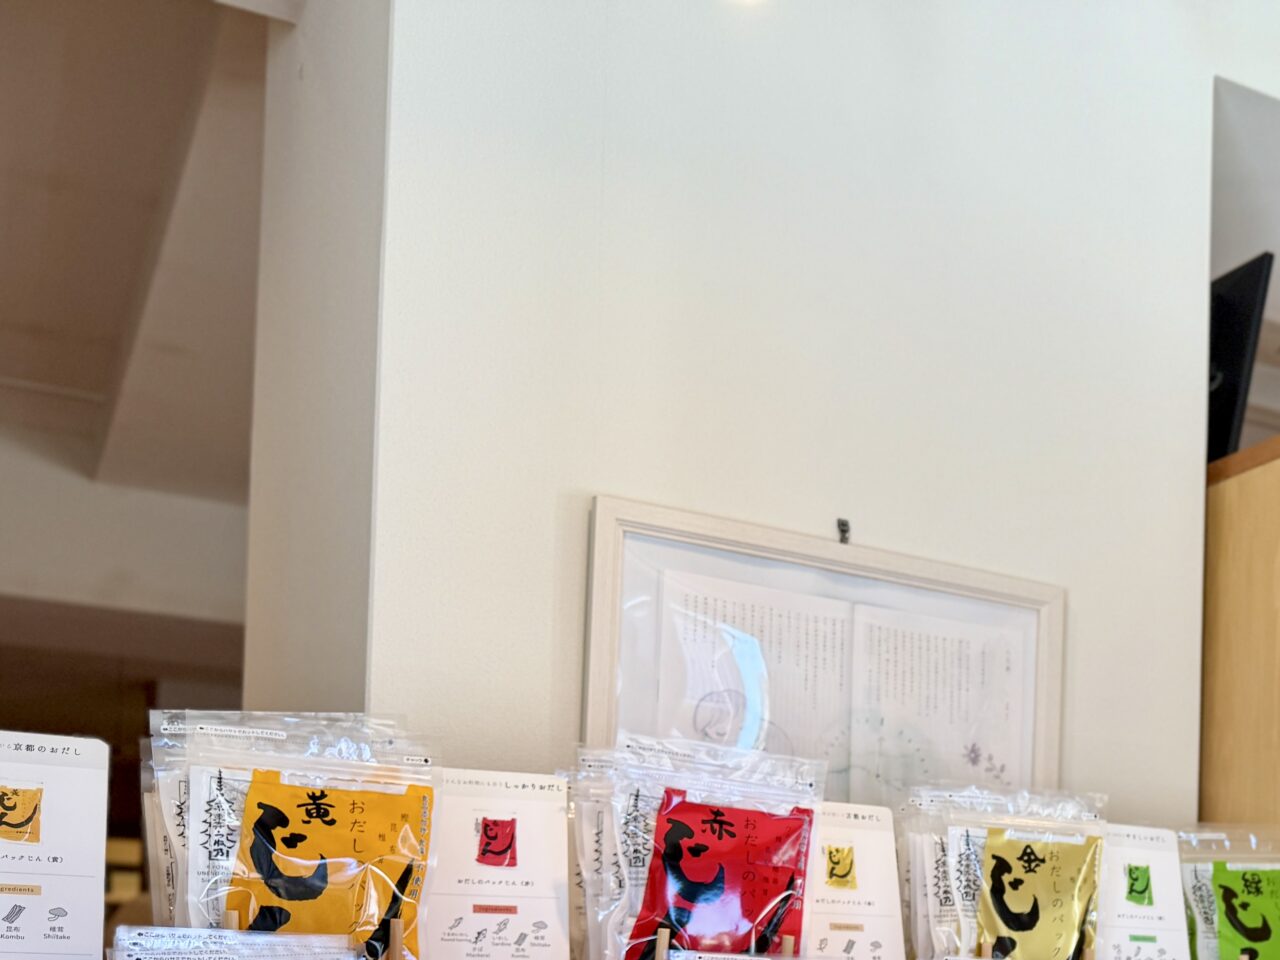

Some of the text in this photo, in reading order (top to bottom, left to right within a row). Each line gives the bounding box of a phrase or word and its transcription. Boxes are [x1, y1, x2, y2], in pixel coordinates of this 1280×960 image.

[13, 743, 80, 756] 京都のおだし
[297, 789, 336, 826] 黄
[701, 808, 737, 841] 赤
[1017, 845, 1046, 873] 金
[1050, 850, 1064, 959] おだしのパック
